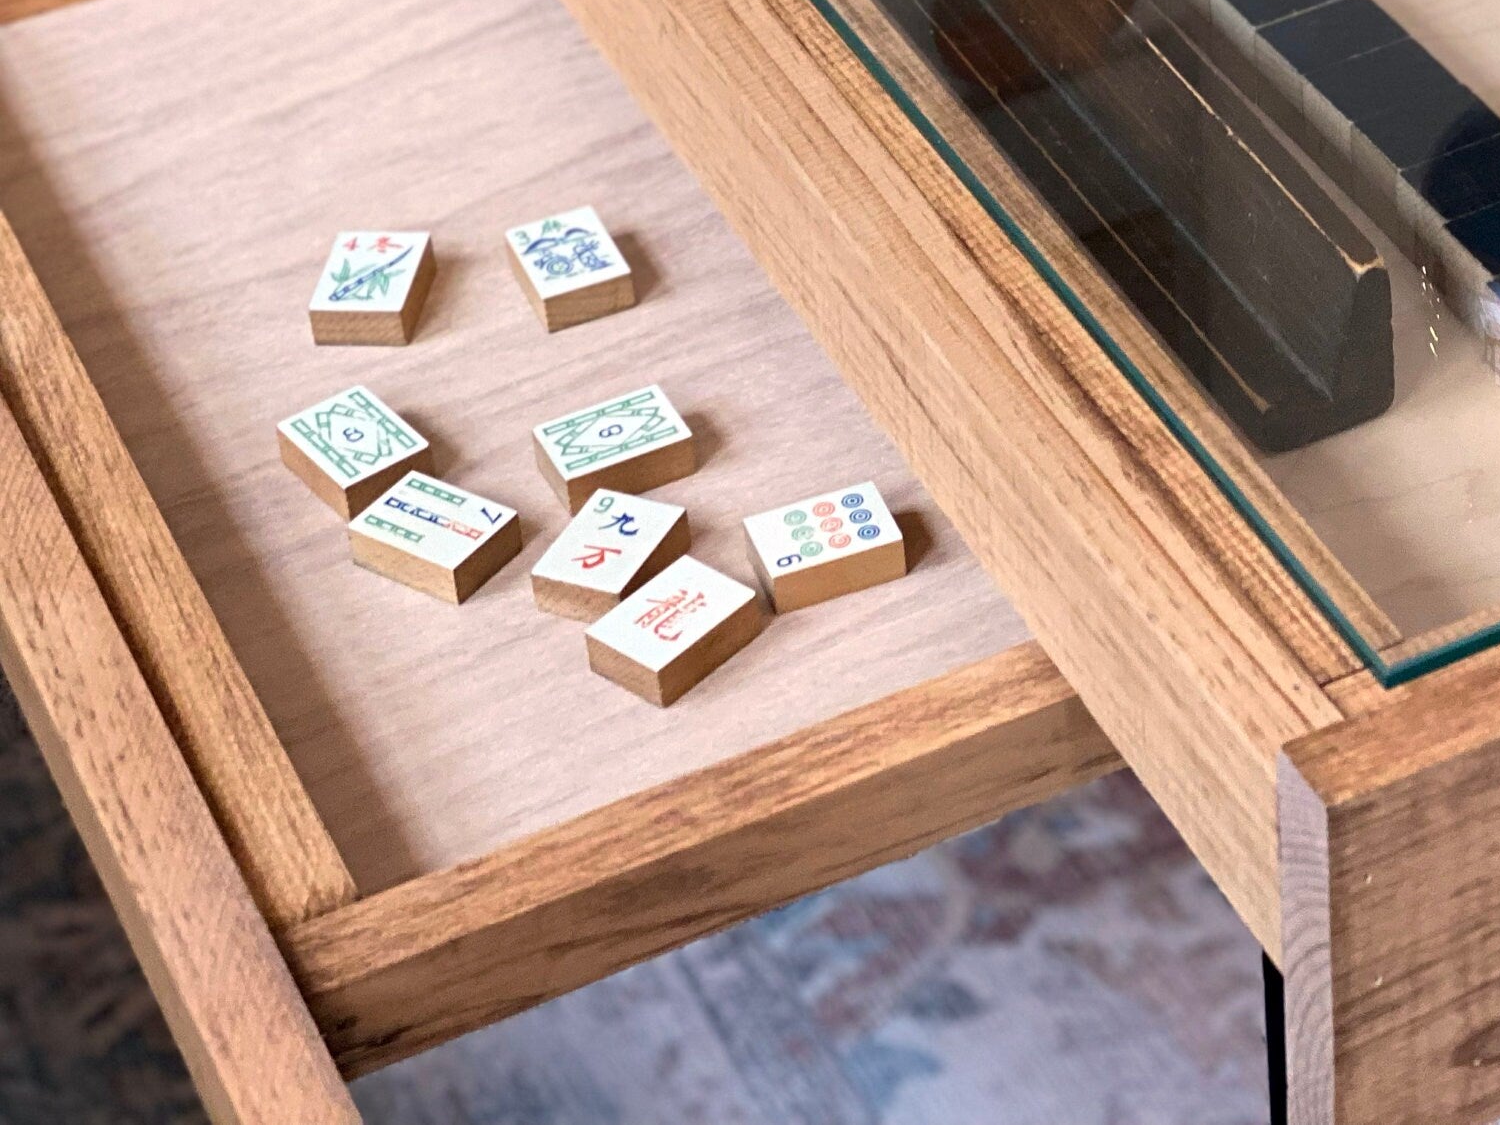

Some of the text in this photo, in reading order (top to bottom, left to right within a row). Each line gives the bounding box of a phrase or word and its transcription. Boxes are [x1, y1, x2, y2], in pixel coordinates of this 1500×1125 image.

[598, 423, 625, 440] 8
[592, 495, 616, 515] 9
[480, 506, 503, 525] 7
